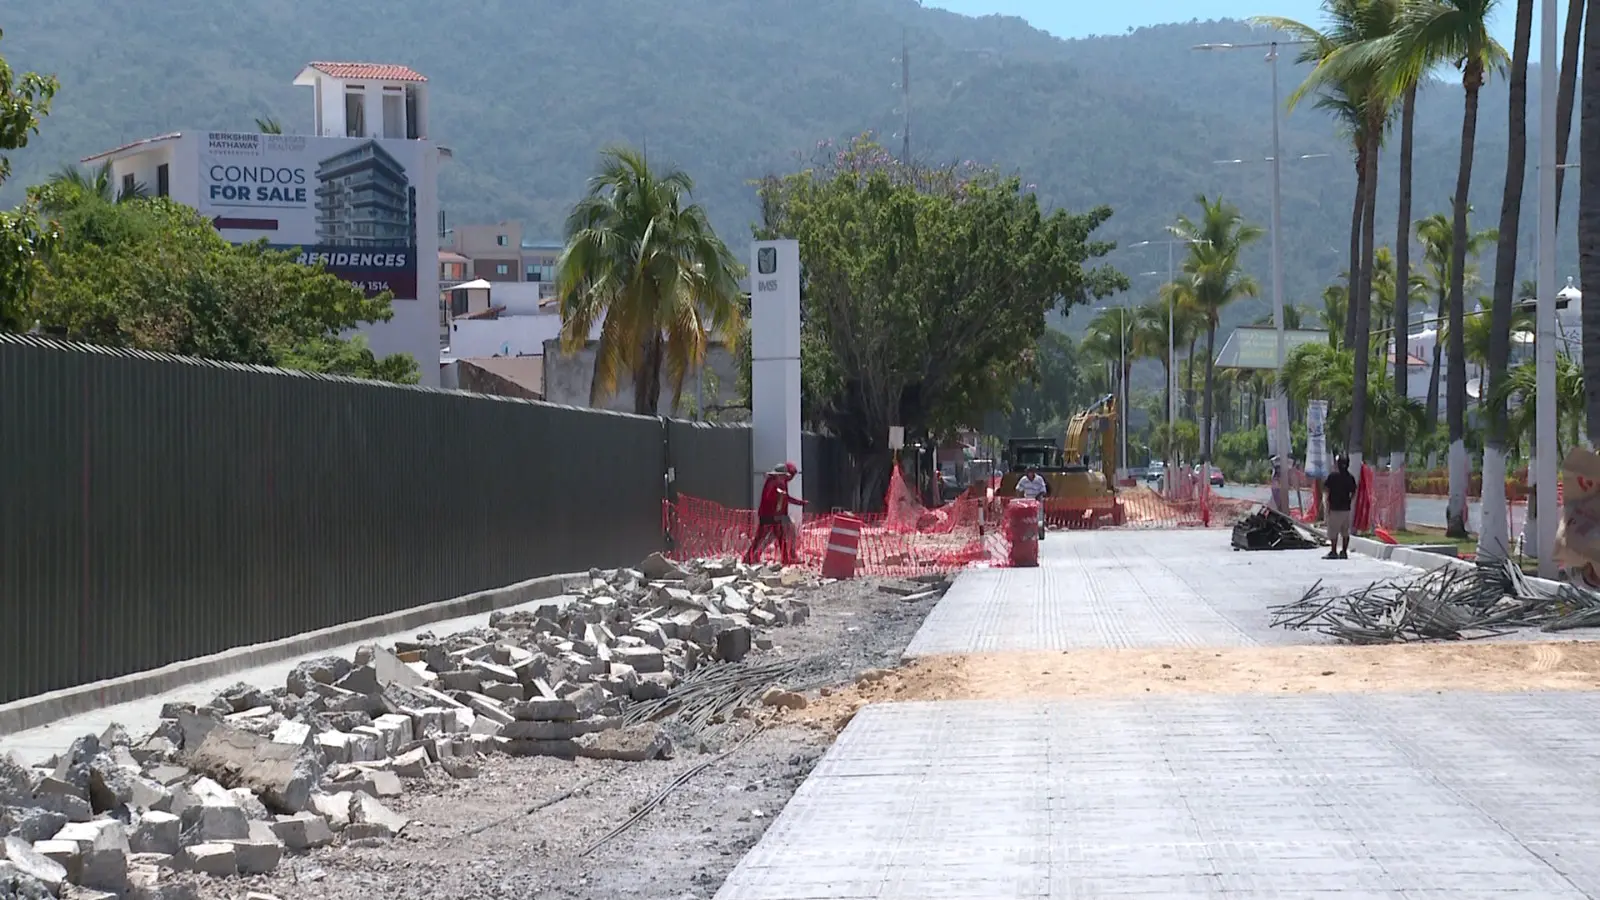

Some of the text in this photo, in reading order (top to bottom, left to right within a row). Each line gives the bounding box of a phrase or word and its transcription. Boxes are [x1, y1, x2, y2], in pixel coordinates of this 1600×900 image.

[208, 132, 259, 142] BERKSHIRE
[208, 141, 259, 149] HATHAWAY
[210, 165, 306, 184] CONDOS
[210, 185, 307, 202] FOR SALE
[296, 252, 406, 267] RESIDENCES
